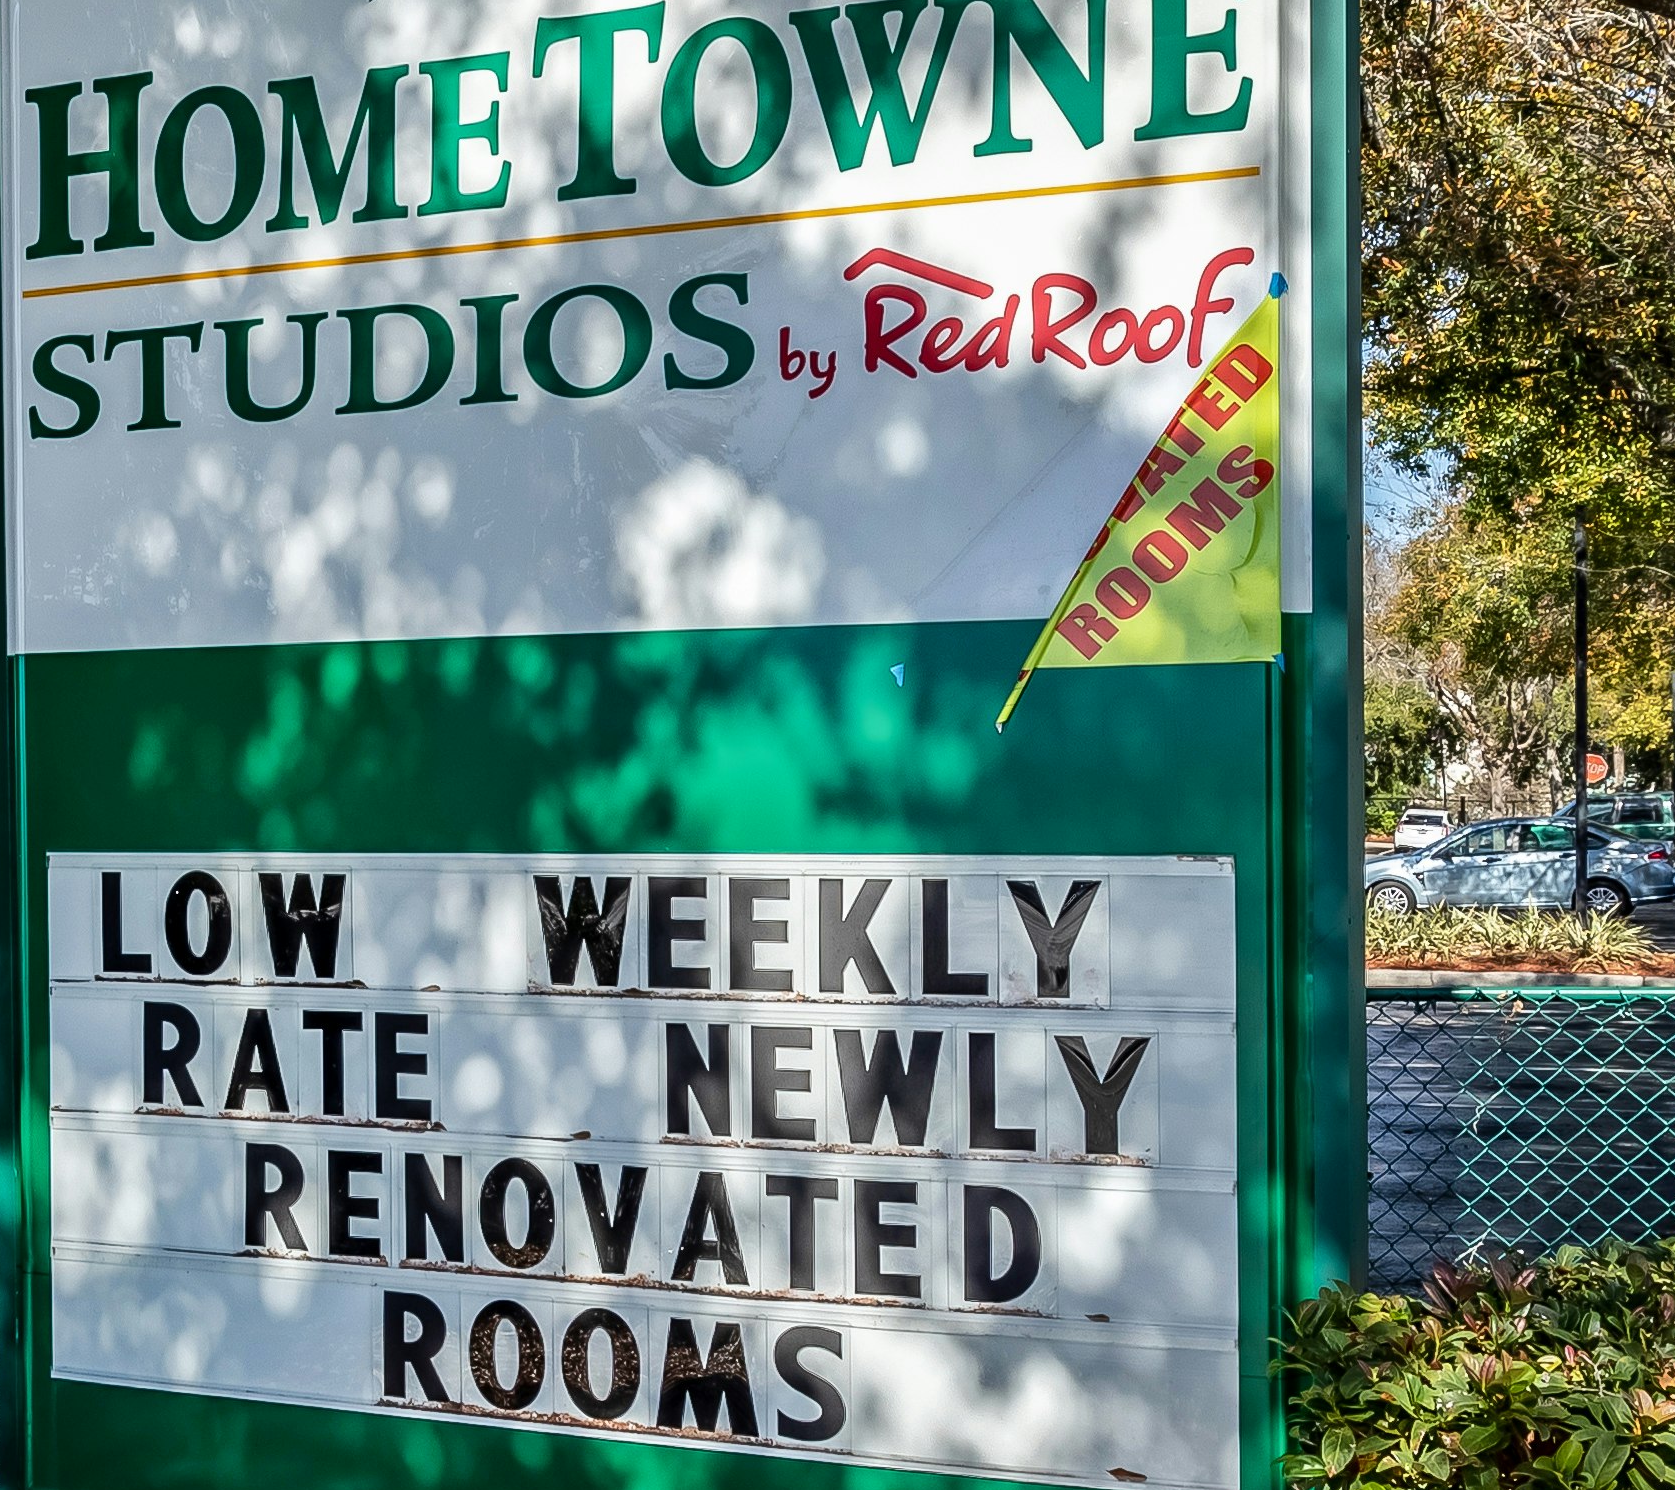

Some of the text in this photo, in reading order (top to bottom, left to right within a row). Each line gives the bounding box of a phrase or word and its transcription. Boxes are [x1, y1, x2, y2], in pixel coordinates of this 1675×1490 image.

[28, 272, 756, 440] STUDIOS
[778, 326, 837, 400] by
[1055, 445, 1275, 660] ROOMS
[99, 869, 1103, 999] LOW WEEKLY
[141, 1001, 1151, 1155] RATE NEWLY
[244, 1142, 1043, 1305] RENOVATED
[382, 1290, 848, 1442] ROOMS
